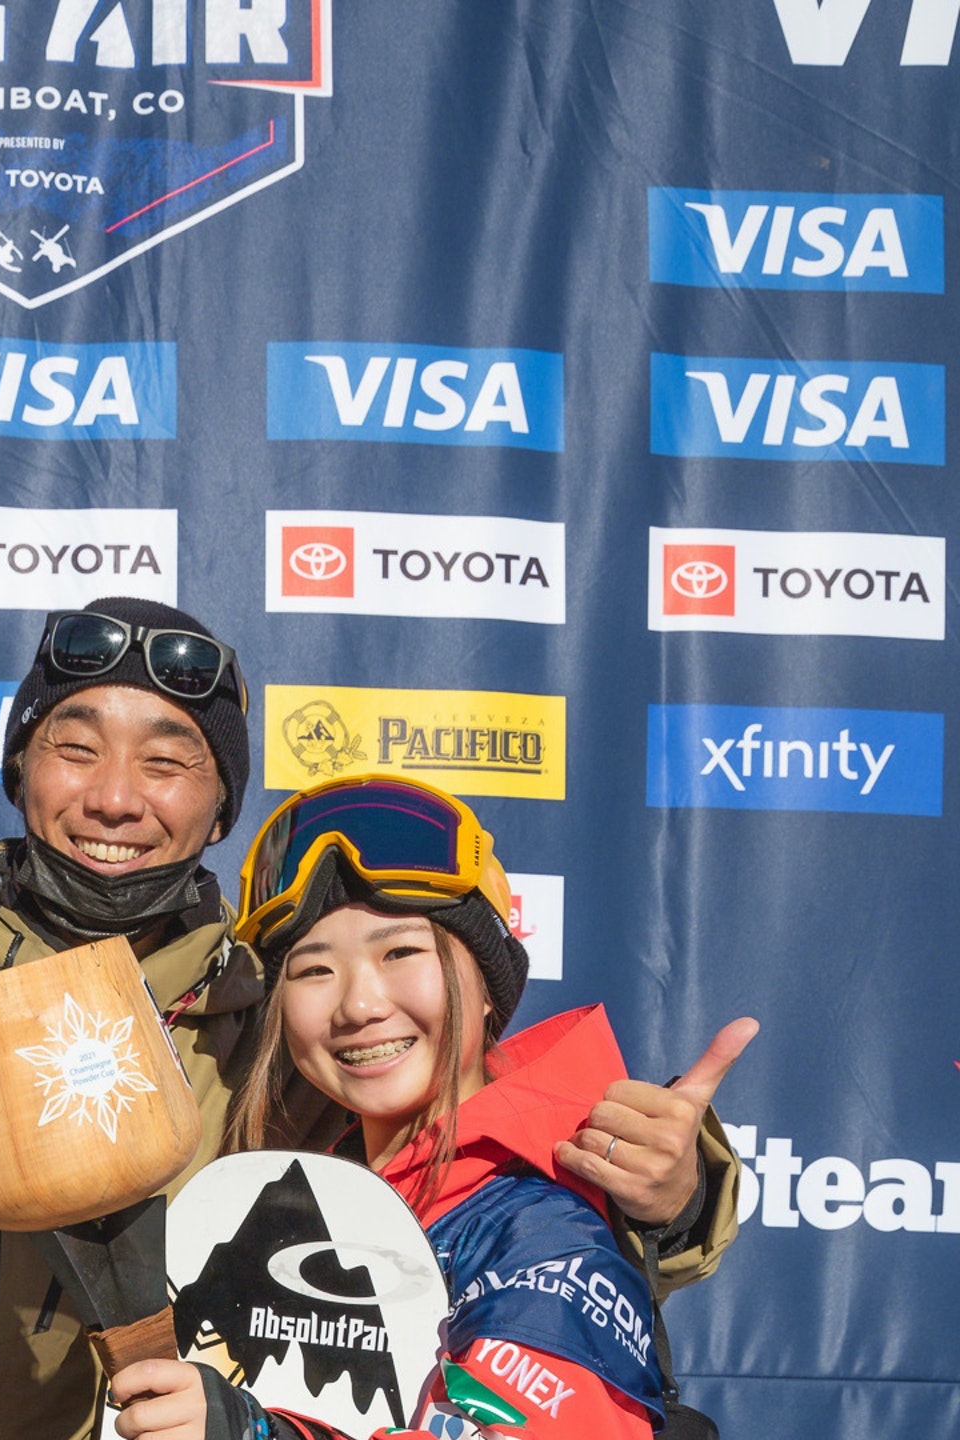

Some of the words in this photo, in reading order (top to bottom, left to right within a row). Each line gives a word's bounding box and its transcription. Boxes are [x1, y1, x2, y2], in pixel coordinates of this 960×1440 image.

[133, 90, 185, 115] CO
[52, 138, 65, 151] BY
[5, 169, 105, 196] TOYOTA
[685, 202, 909, 278] VISA
[305, 355, 530, 434] VISA
[685, 371, 910, 449] VISA
[372, 548, 550, 588] TOYOTA
[753, 567, 931, 603] TOYOTA
[434, 714, 545, 726] CERVEZA
[377, 717, 547, 764] PACIFICO
[700, 723, 895, 795] xfinity
[69, 1058, 113, 1077] Champagne
[80, 1051, 97, 1063] 2021
[72, 1072, 100, 1087] Powder
[102, 1068, 116, 1082] Cup
[475, 1338, 576, 1419] YONEX
